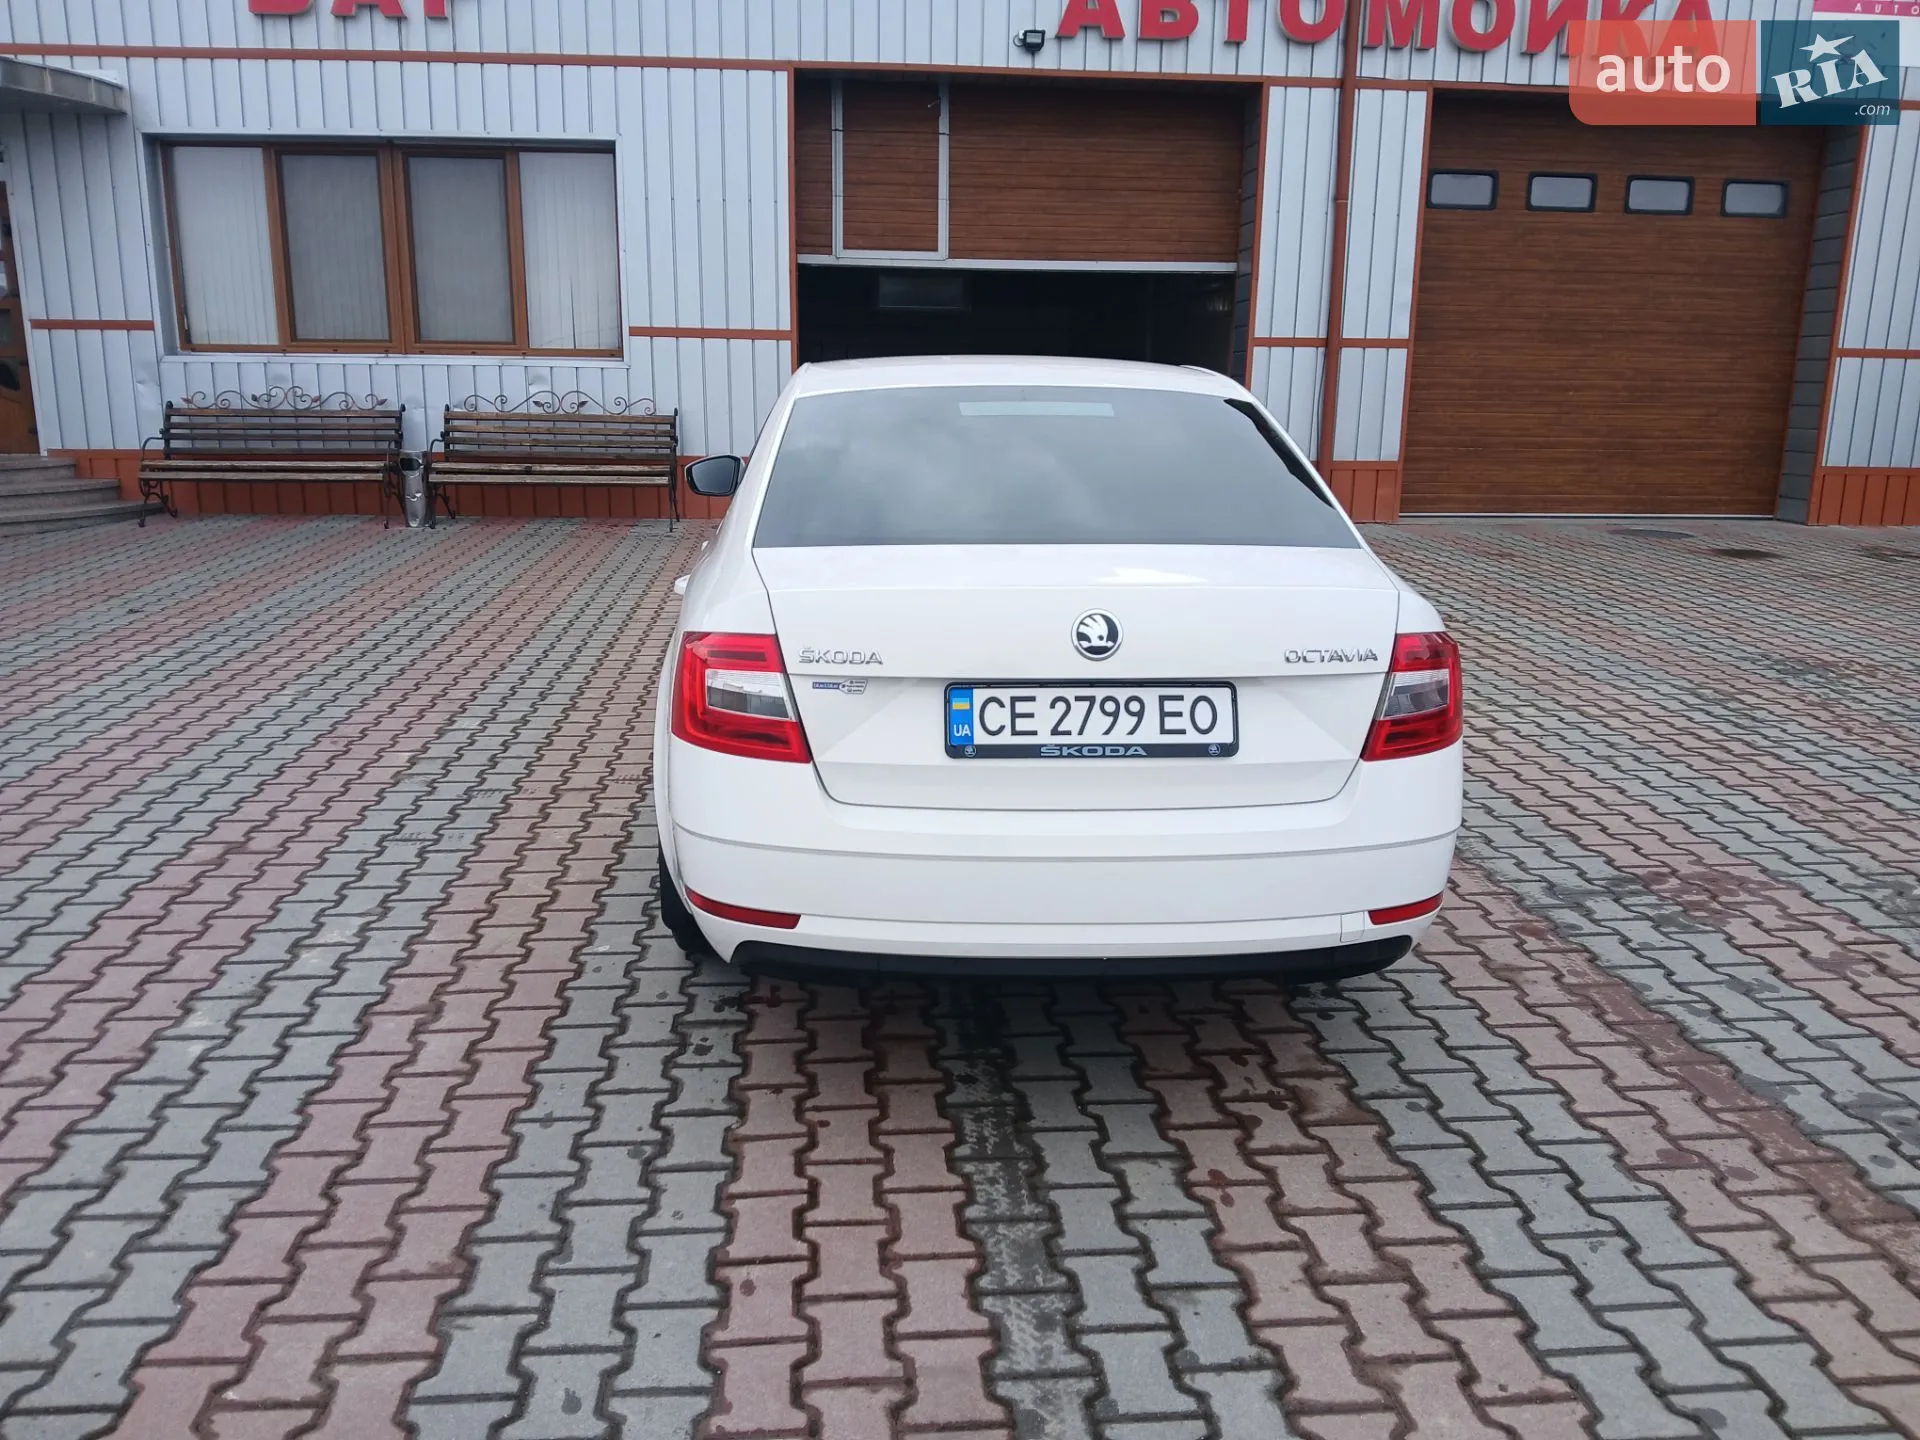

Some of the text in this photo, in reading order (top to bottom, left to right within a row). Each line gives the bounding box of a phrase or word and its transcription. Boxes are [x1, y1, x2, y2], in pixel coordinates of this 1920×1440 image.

[799, 645, 883, 665] ŠKODA
[1284, 648, 1378, 664] OCTAVIA
[978, 695, 1038, 736] CE
[1049, 695, 1145, 736] 2799
[953, 724, 971, 737] UA
[1040, 743, 1148, 757] ŠKODA
